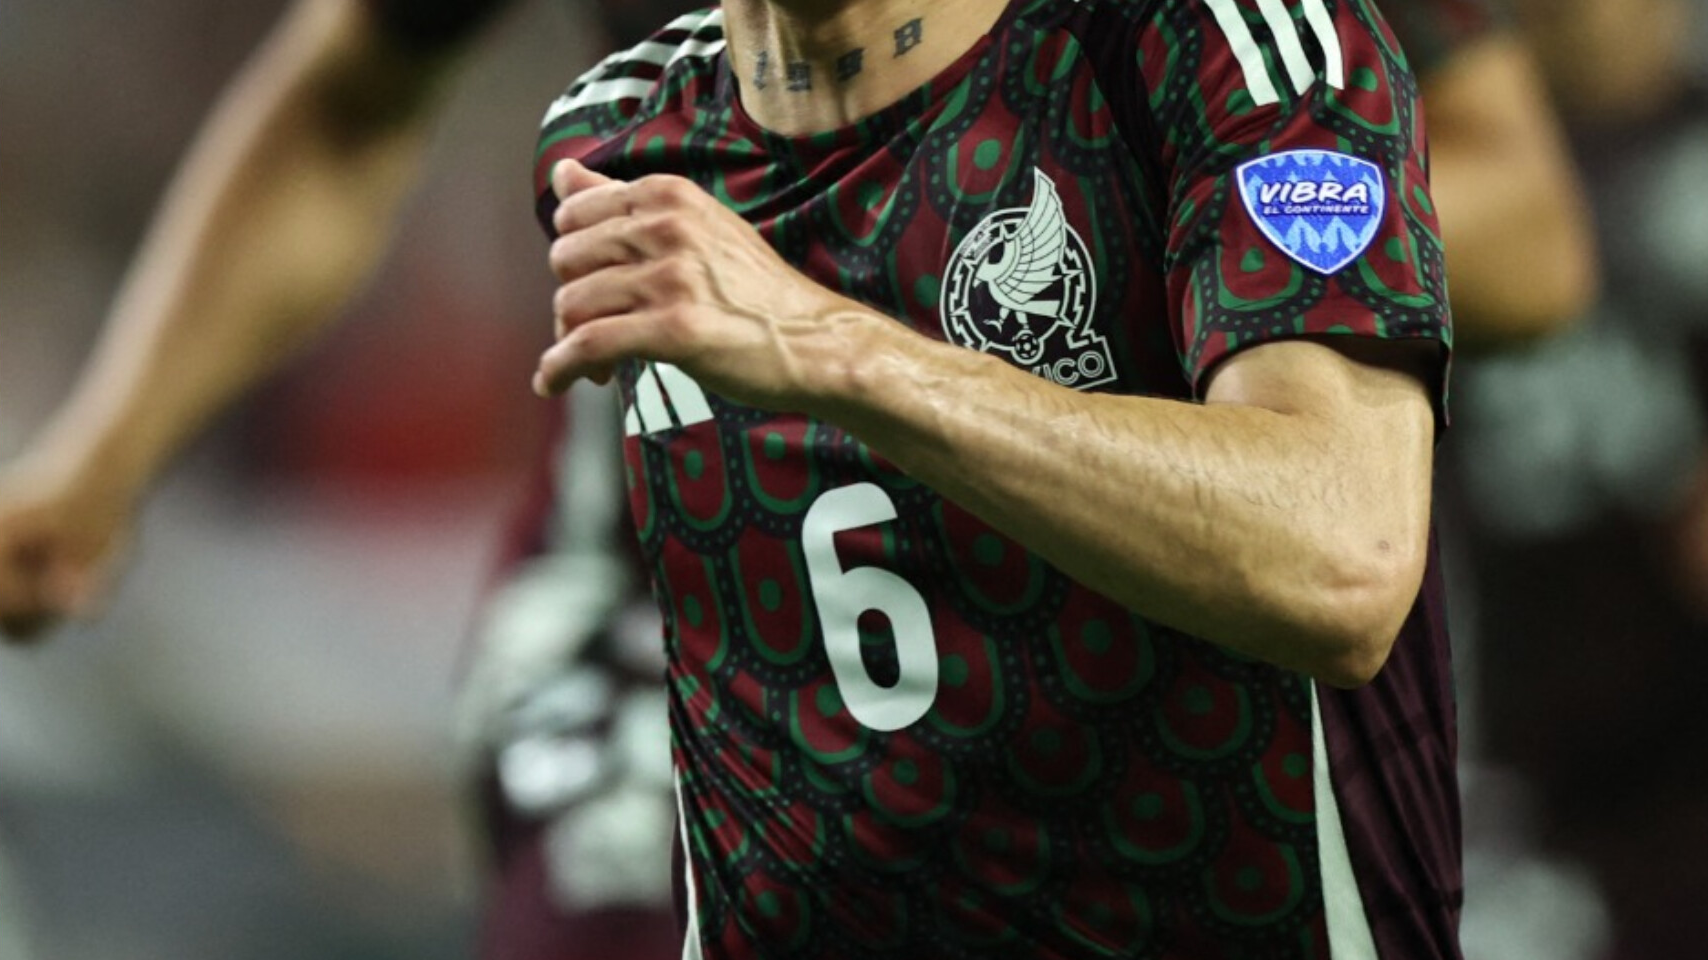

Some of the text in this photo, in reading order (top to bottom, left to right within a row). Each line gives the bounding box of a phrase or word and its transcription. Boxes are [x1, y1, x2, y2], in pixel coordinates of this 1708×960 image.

[1260, 181, 1368, 204] VIBRA
[1263, 205, 1369, 215] EL CONTINENTE
[802, 482, 939, 732] 6
